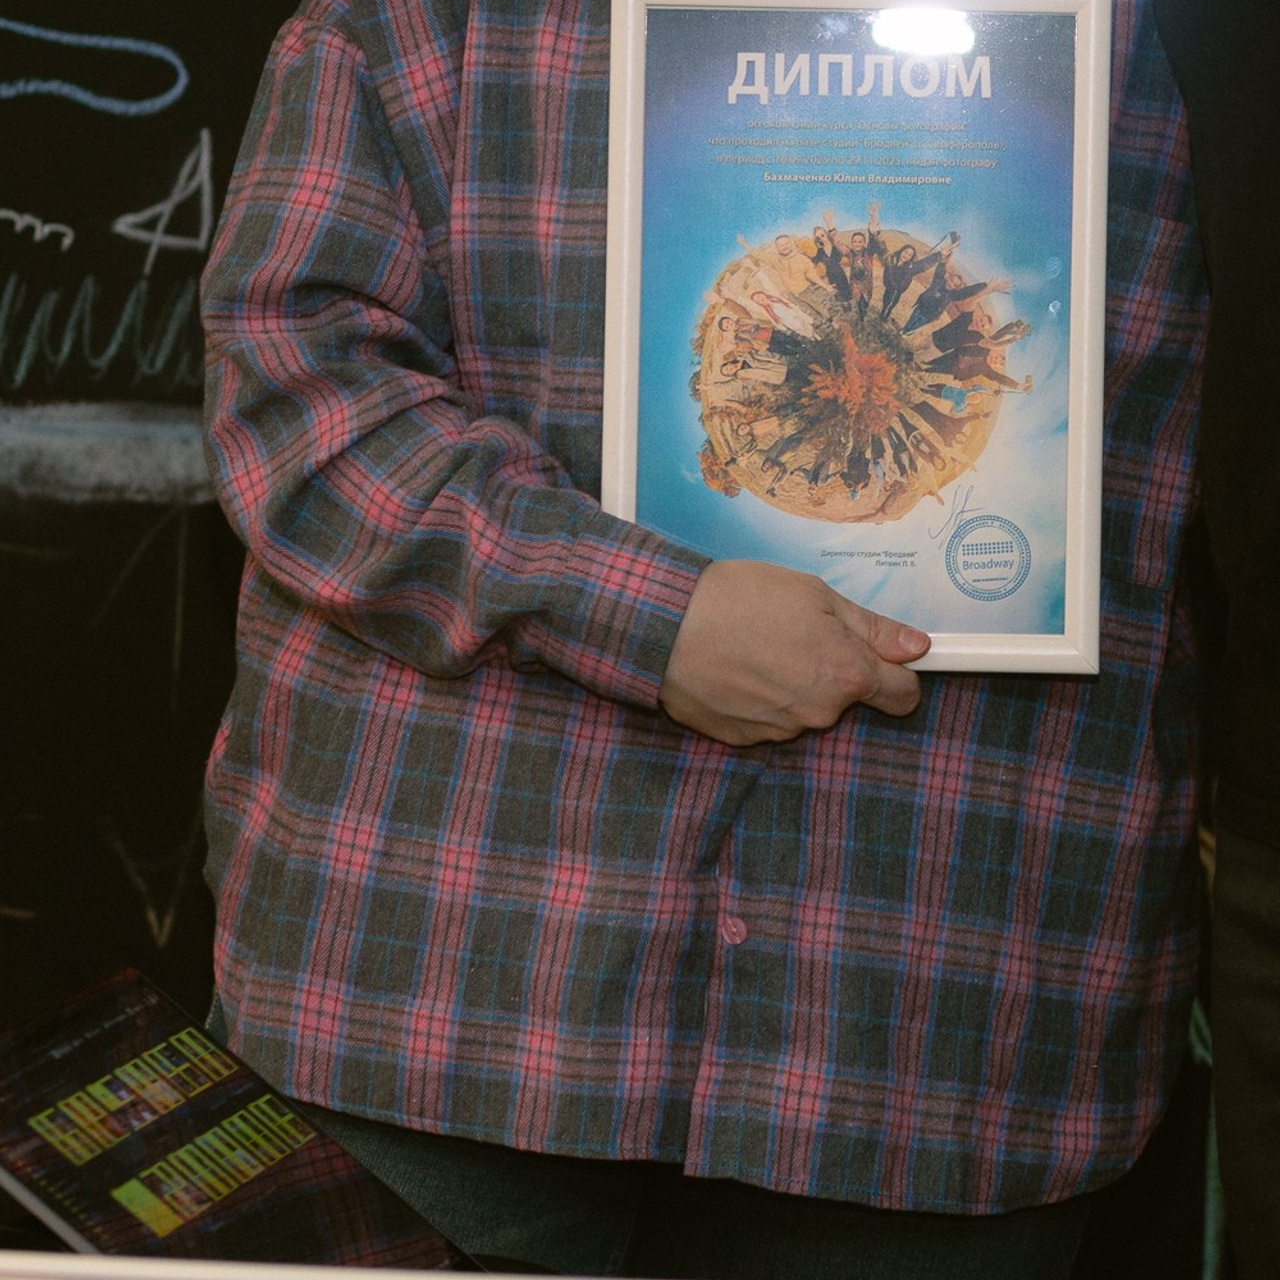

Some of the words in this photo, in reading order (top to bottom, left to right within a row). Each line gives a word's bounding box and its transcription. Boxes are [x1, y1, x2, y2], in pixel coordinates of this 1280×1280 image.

[727, 52, 992, 105] ДИПЛОМ
[763, 171, 831, 183] Бахмаченко
[834, 172, 865, 183] Юлии
[868, 173, 953, 186] Владимировне
[820, 548, 856, 559] Директор
[856, 551, 881, 559] студии
[962, 558, 1015, 571] Broadway
